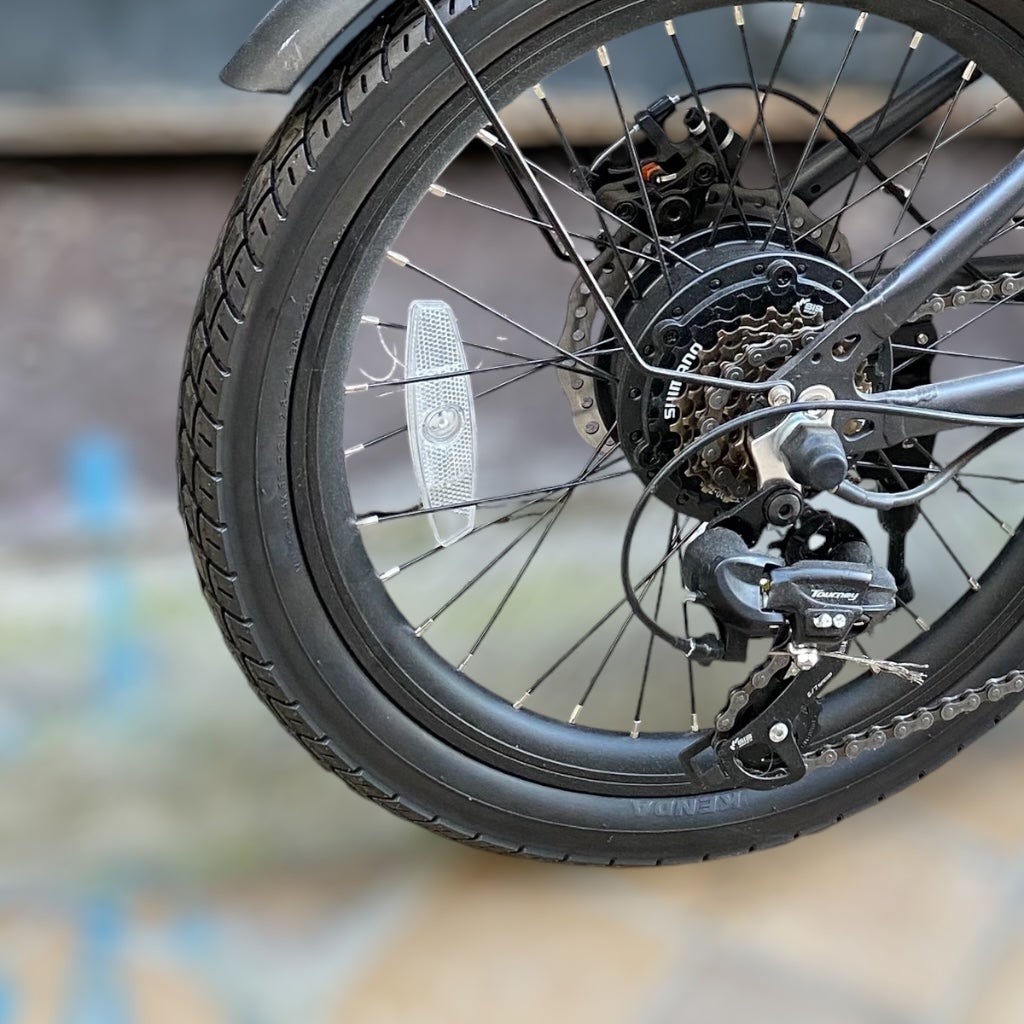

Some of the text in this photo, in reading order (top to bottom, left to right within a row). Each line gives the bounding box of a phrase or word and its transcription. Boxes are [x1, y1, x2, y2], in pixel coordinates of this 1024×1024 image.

[664, 342, 704, 419] SHIMANO
[811, 589, 860, 601] Tourney
[631, 790, 743, 817] KENDA
